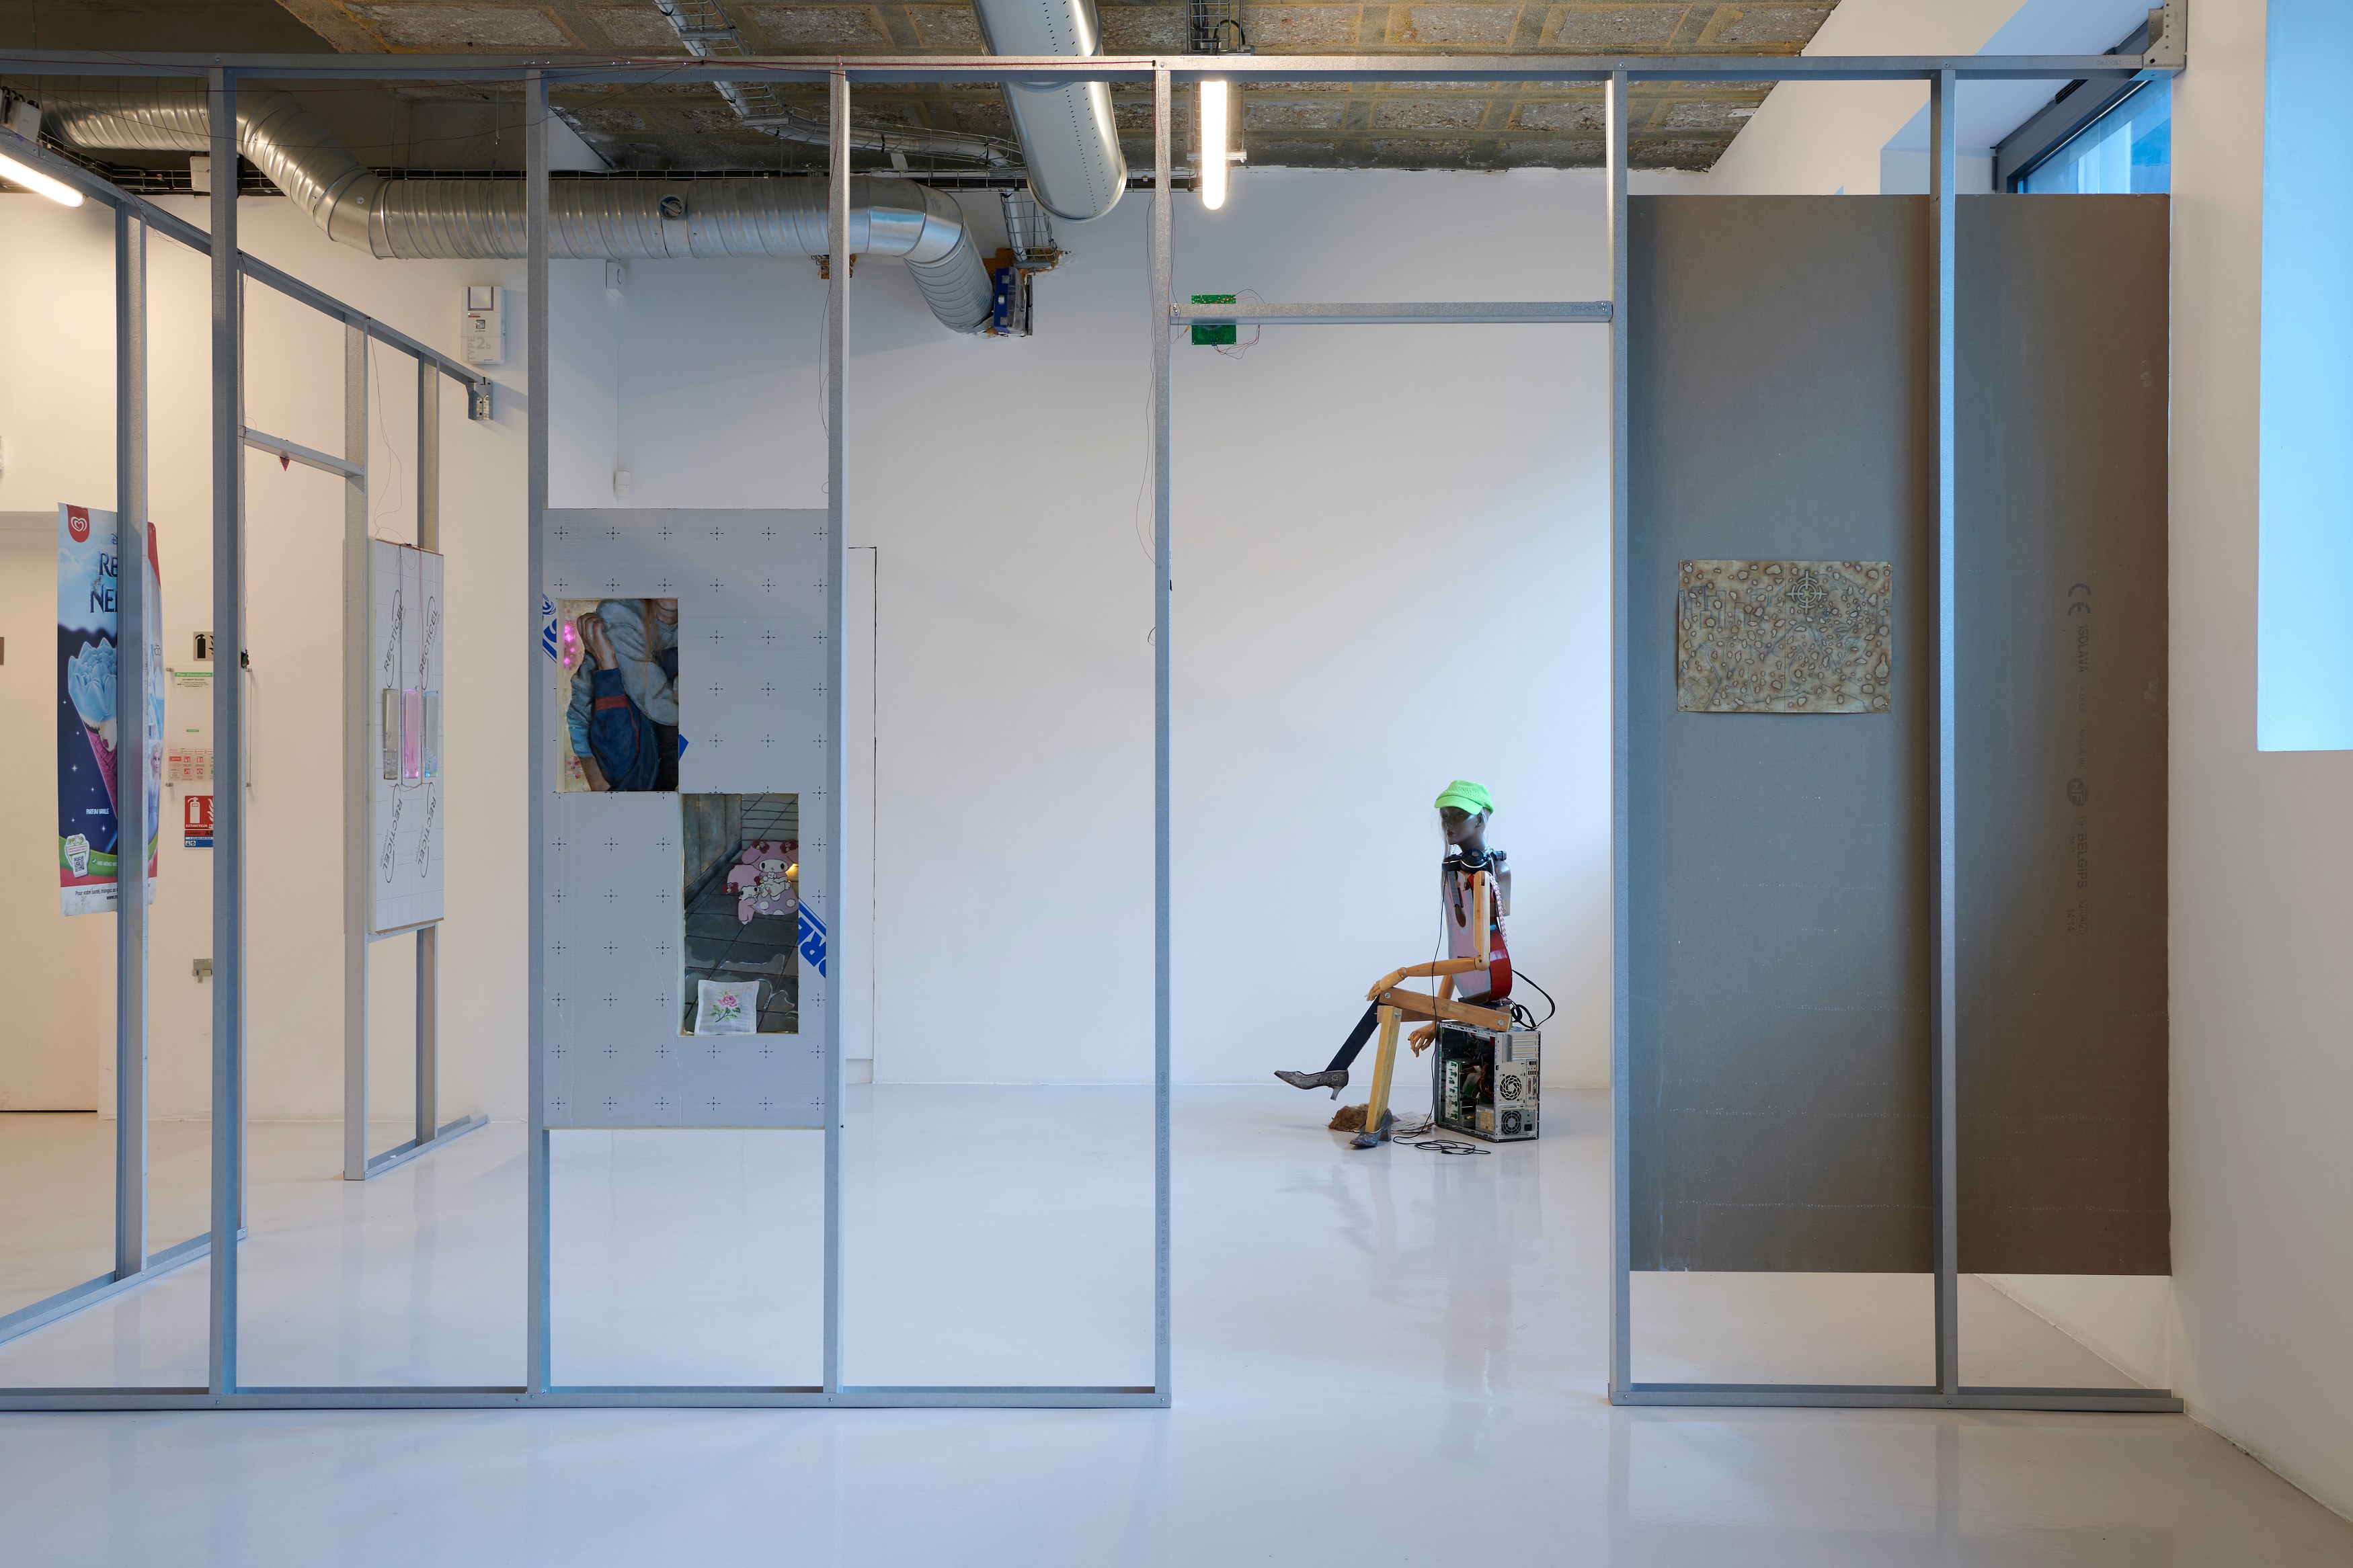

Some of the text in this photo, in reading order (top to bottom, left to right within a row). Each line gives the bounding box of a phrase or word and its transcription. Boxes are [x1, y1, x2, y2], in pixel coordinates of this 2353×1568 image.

[467, 336, 491, 362] TYPE 2b
[2077, 625, 2089, 673] ISOLAVA
[2077, 833, 2087, 889] BELGIPS
[1160, 1208, 1166, 1216] EN
